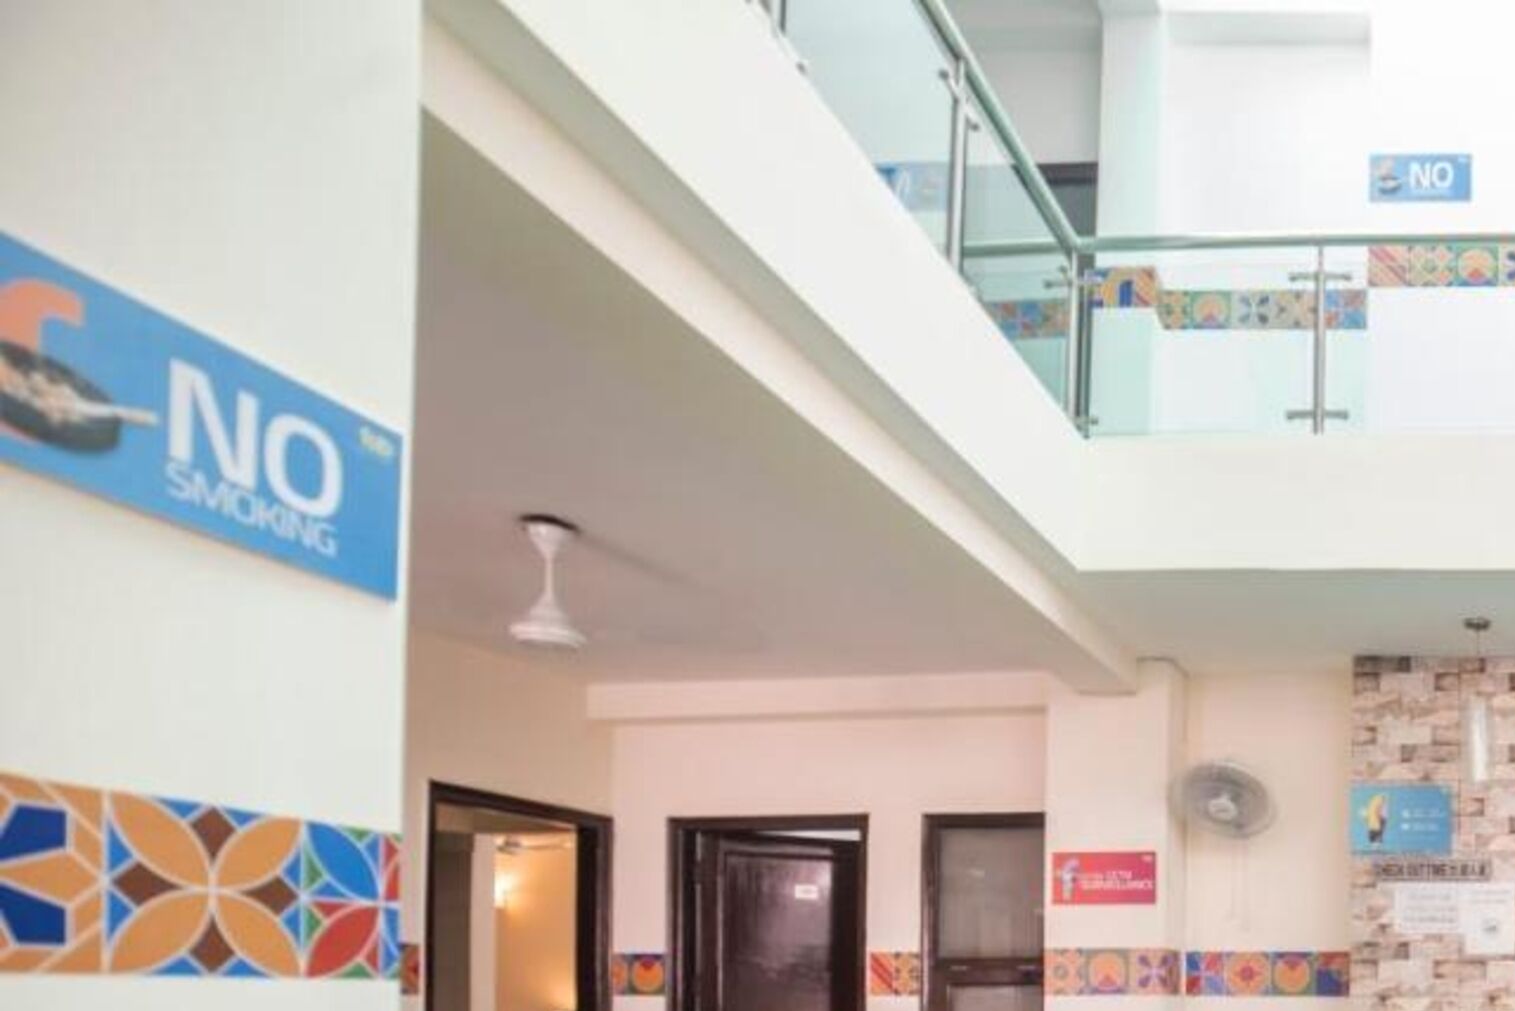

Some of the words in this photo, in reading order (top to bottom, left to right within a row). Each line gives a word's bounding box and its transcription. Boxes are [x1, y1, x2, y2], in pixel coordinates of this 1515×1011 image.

[1409, 160, 1454, 190] NO
[168, 357, 343, 519] NO
[165, 461, 338, 557] SMOKING
